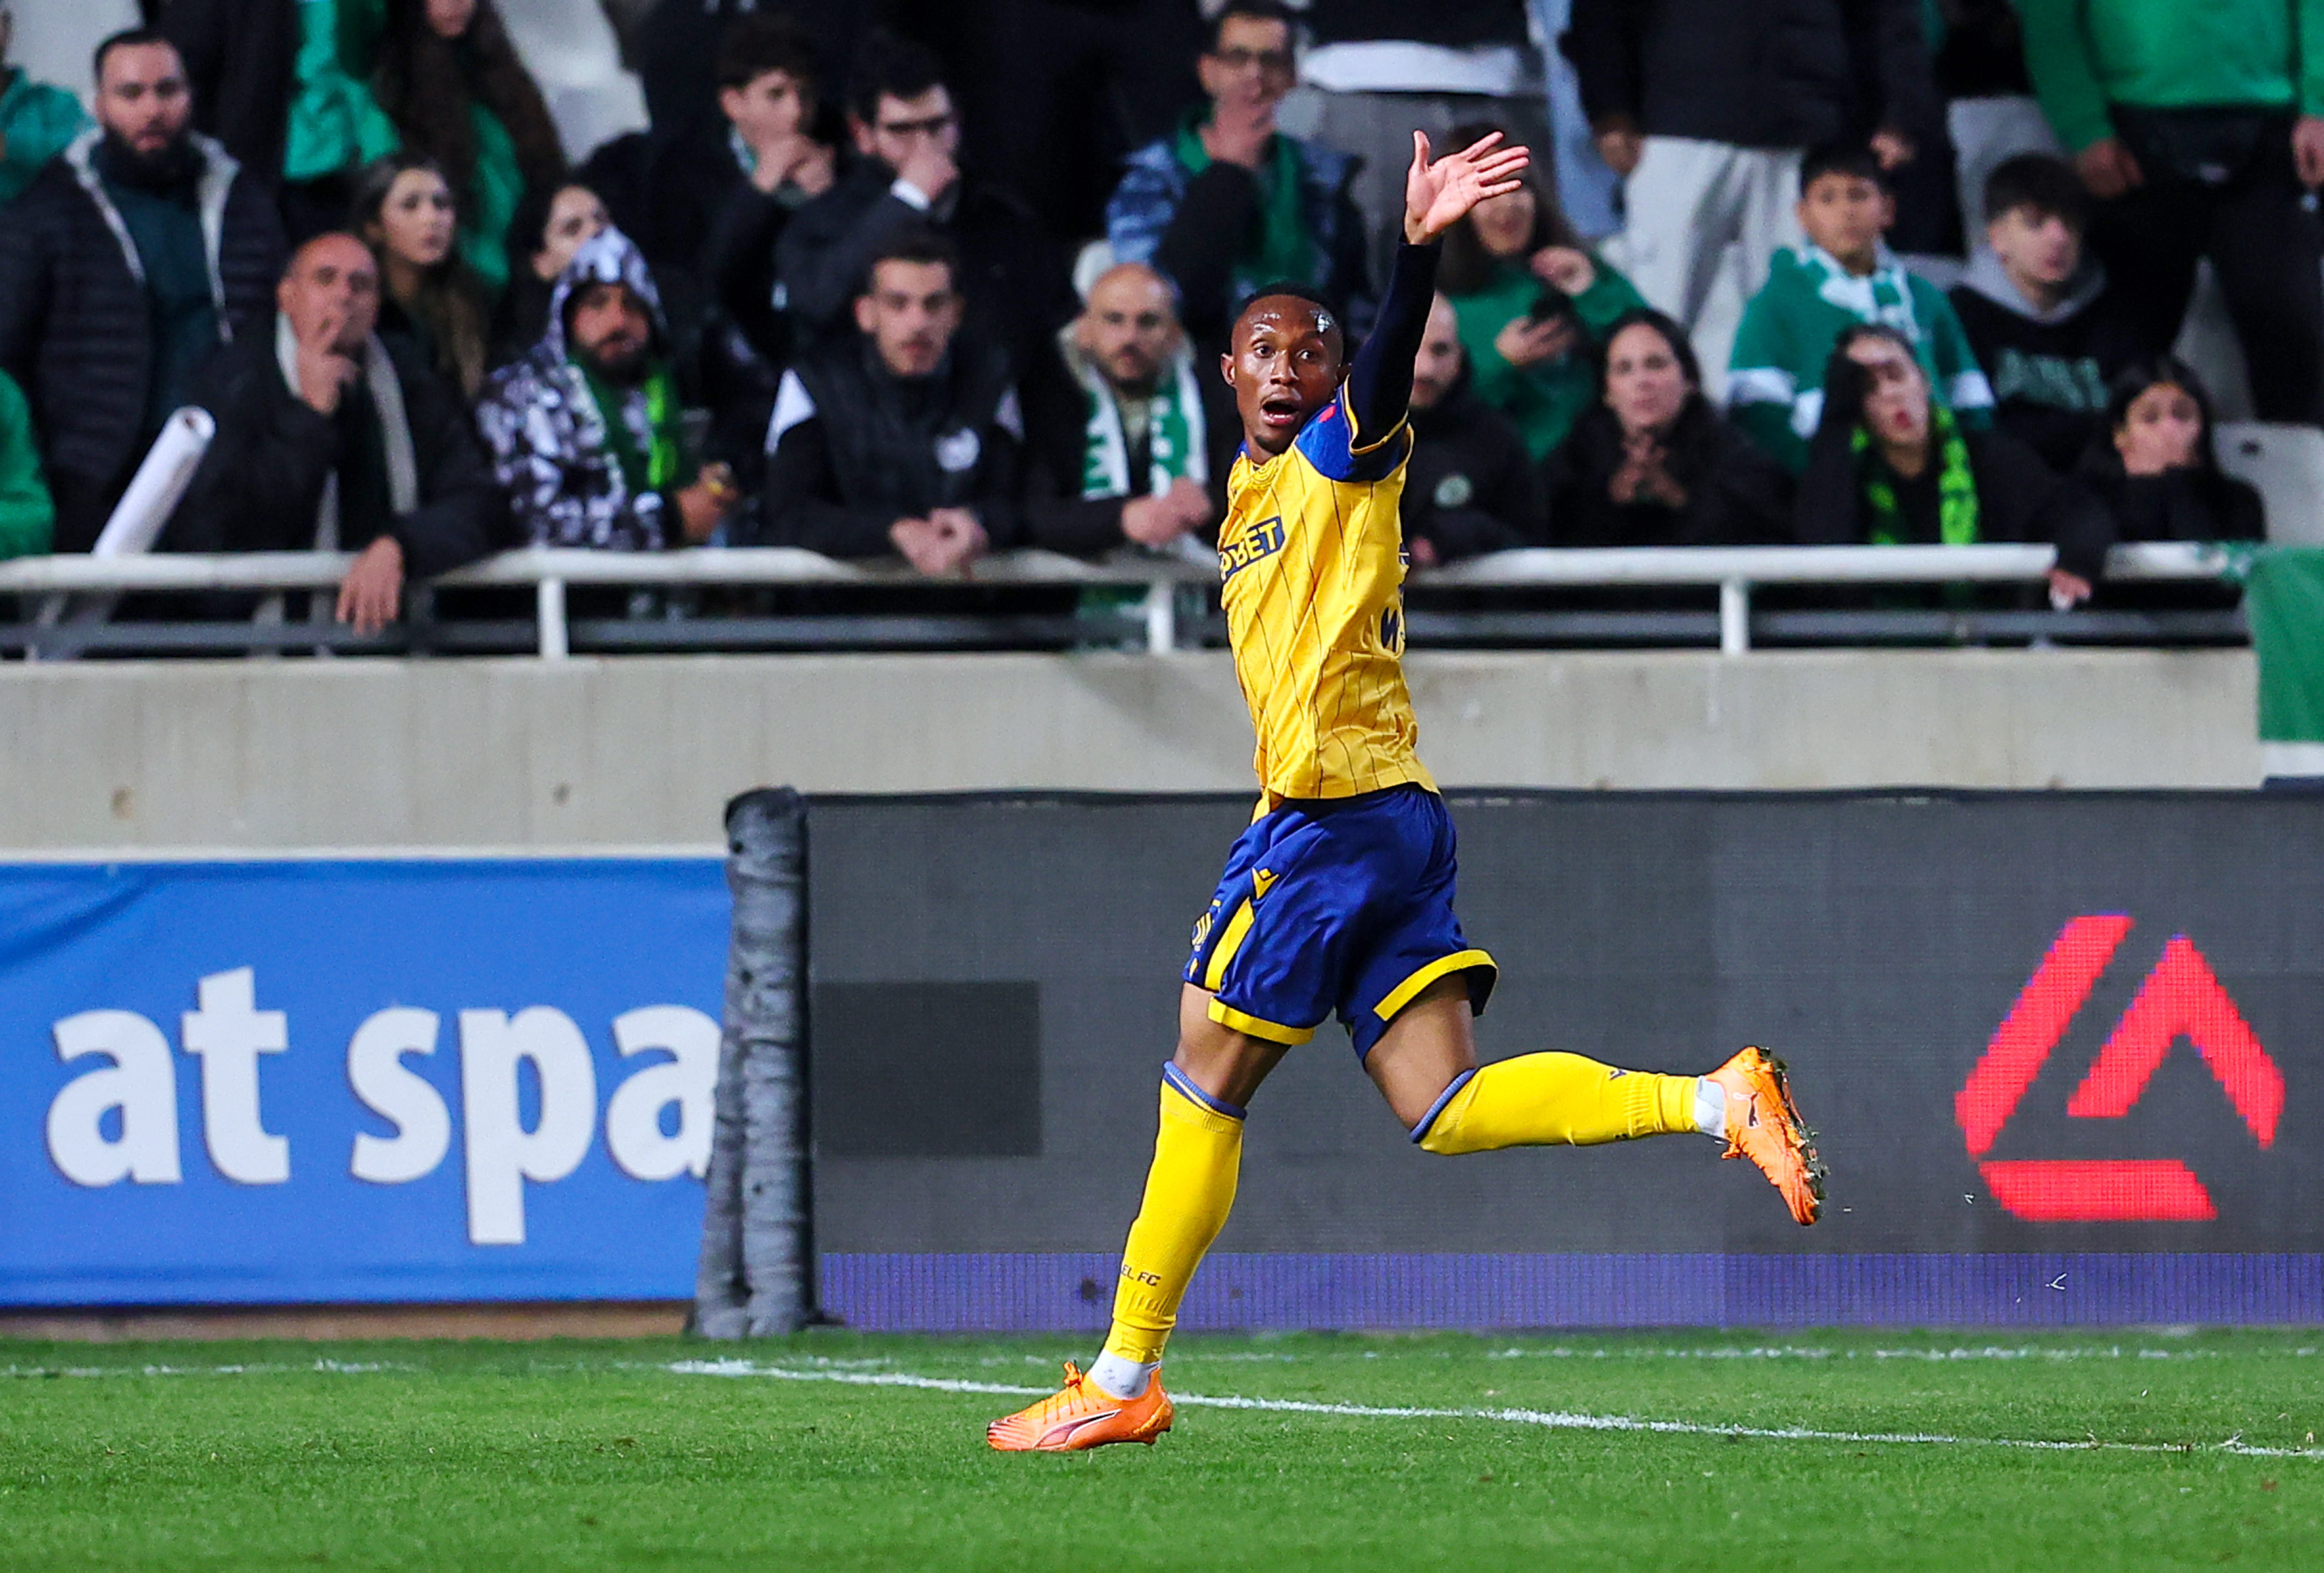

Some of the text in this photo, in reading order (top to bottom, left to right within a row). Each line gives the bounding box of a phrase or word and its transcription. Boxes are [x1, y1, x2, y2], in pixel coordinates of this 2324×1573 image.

[46, 966, 723, 1244] at spa
[1137, 1271, 1161, 1286] FC
